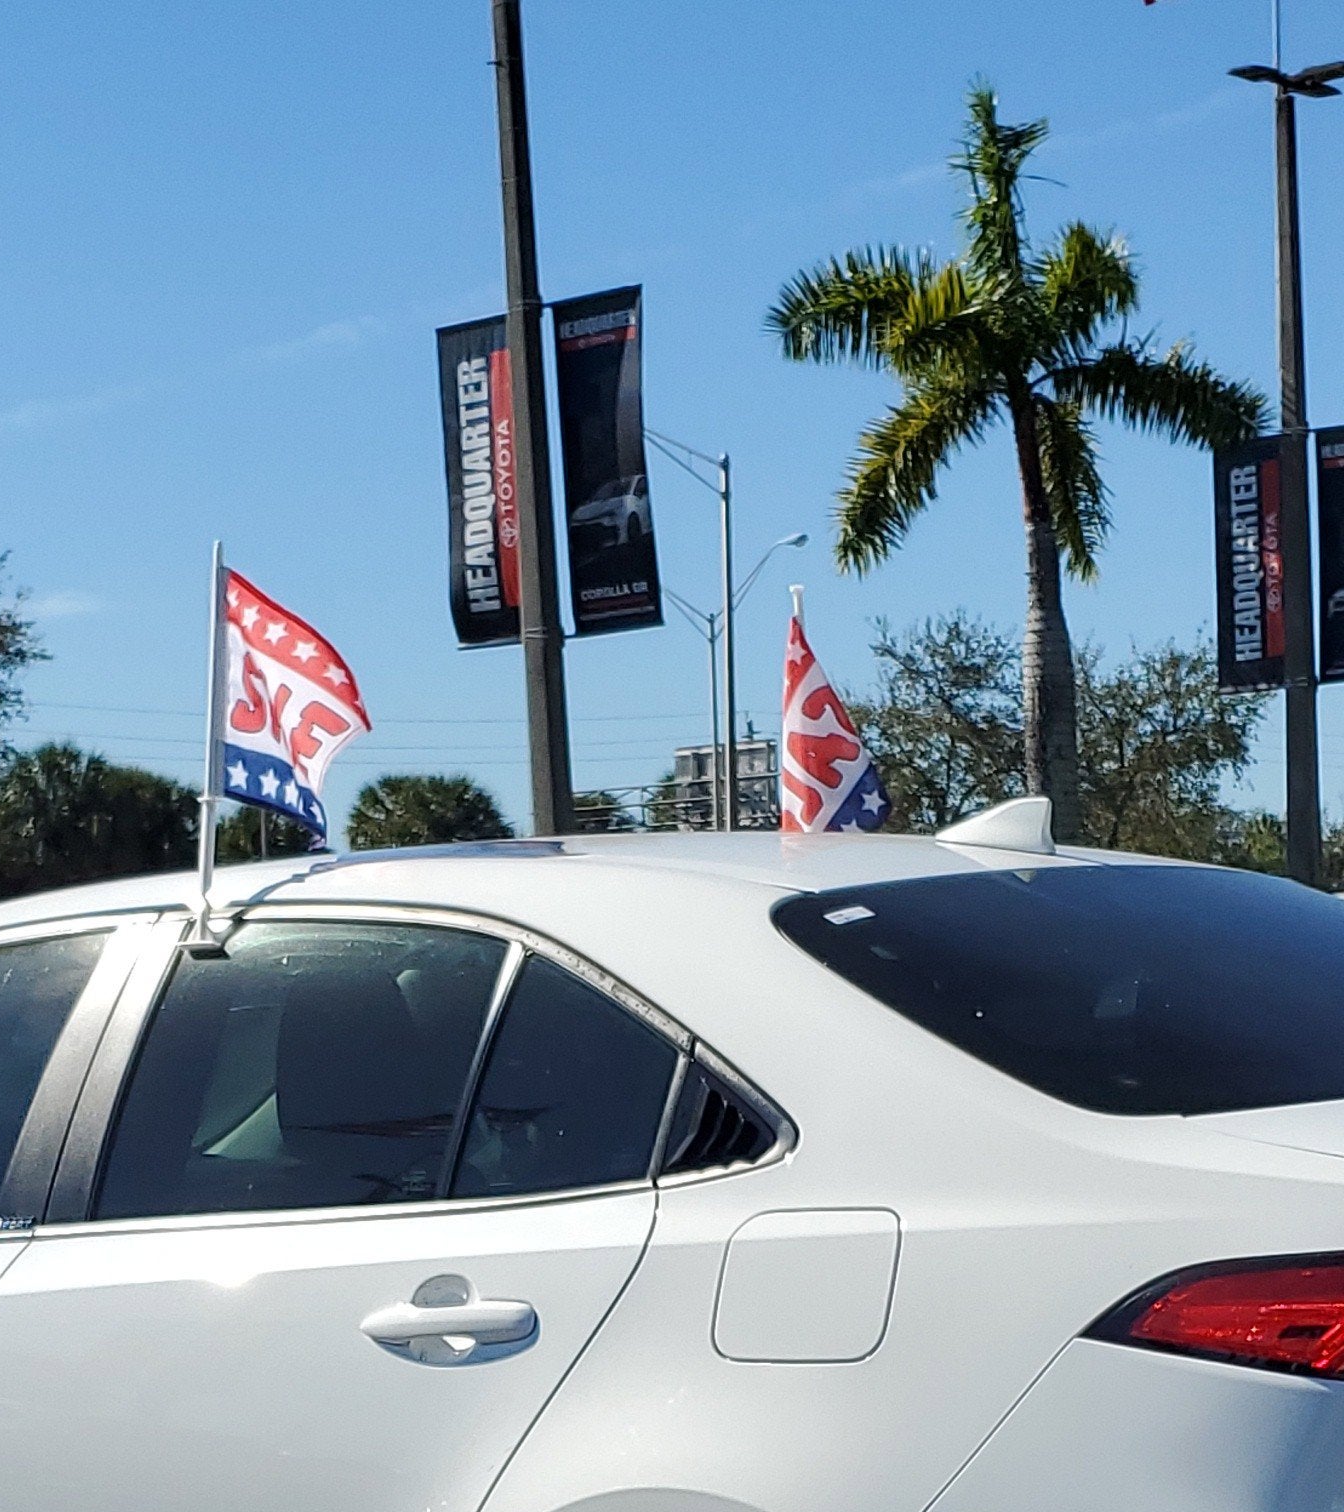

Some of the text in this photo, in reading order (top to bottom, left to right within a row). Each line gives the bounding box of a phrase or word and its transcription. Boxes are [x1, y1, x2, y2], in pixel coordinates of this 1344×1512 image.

[457, 355, 501, 613] HEADQUARTER
[495, 419, 514, 513] TOYOTA
[1229, 465, 1263, 662] HEADQUARTER
